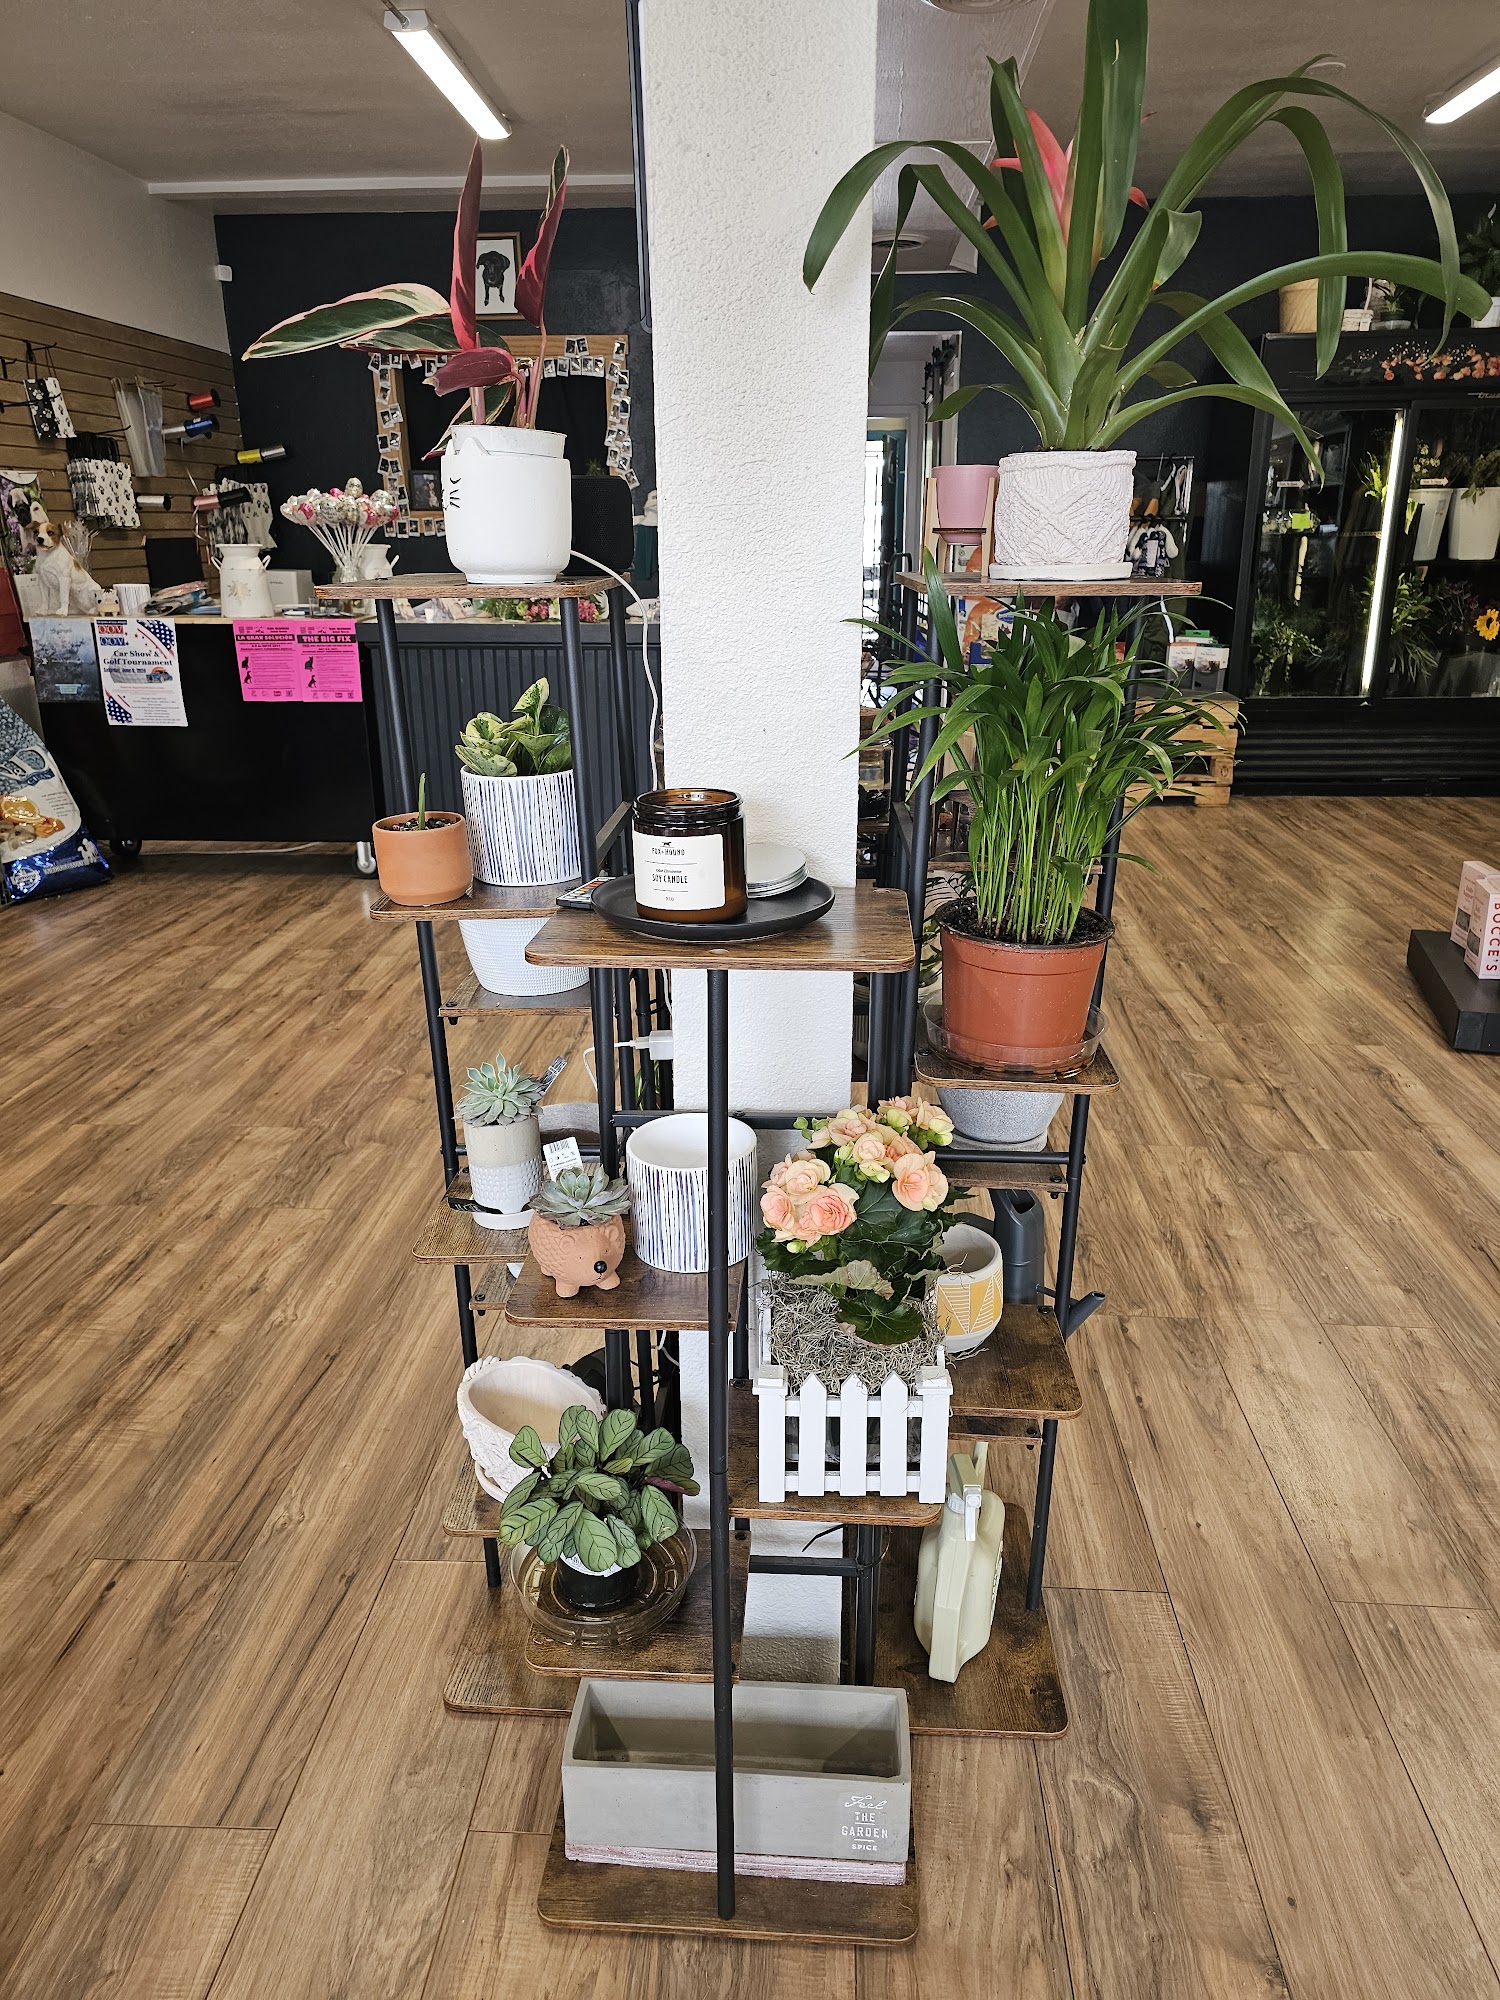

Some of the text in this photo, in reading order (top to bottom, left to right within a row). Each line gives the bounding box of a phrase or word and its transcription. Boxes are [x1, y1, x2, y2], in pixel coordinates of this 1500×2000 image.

[652, 874, 688, 883] SOY CANDLE
[844, 1795, 888, 1810] Feel
[854, 1812, 876, 1822] THE
[841, 1826, 888, 1838] GARDEN
